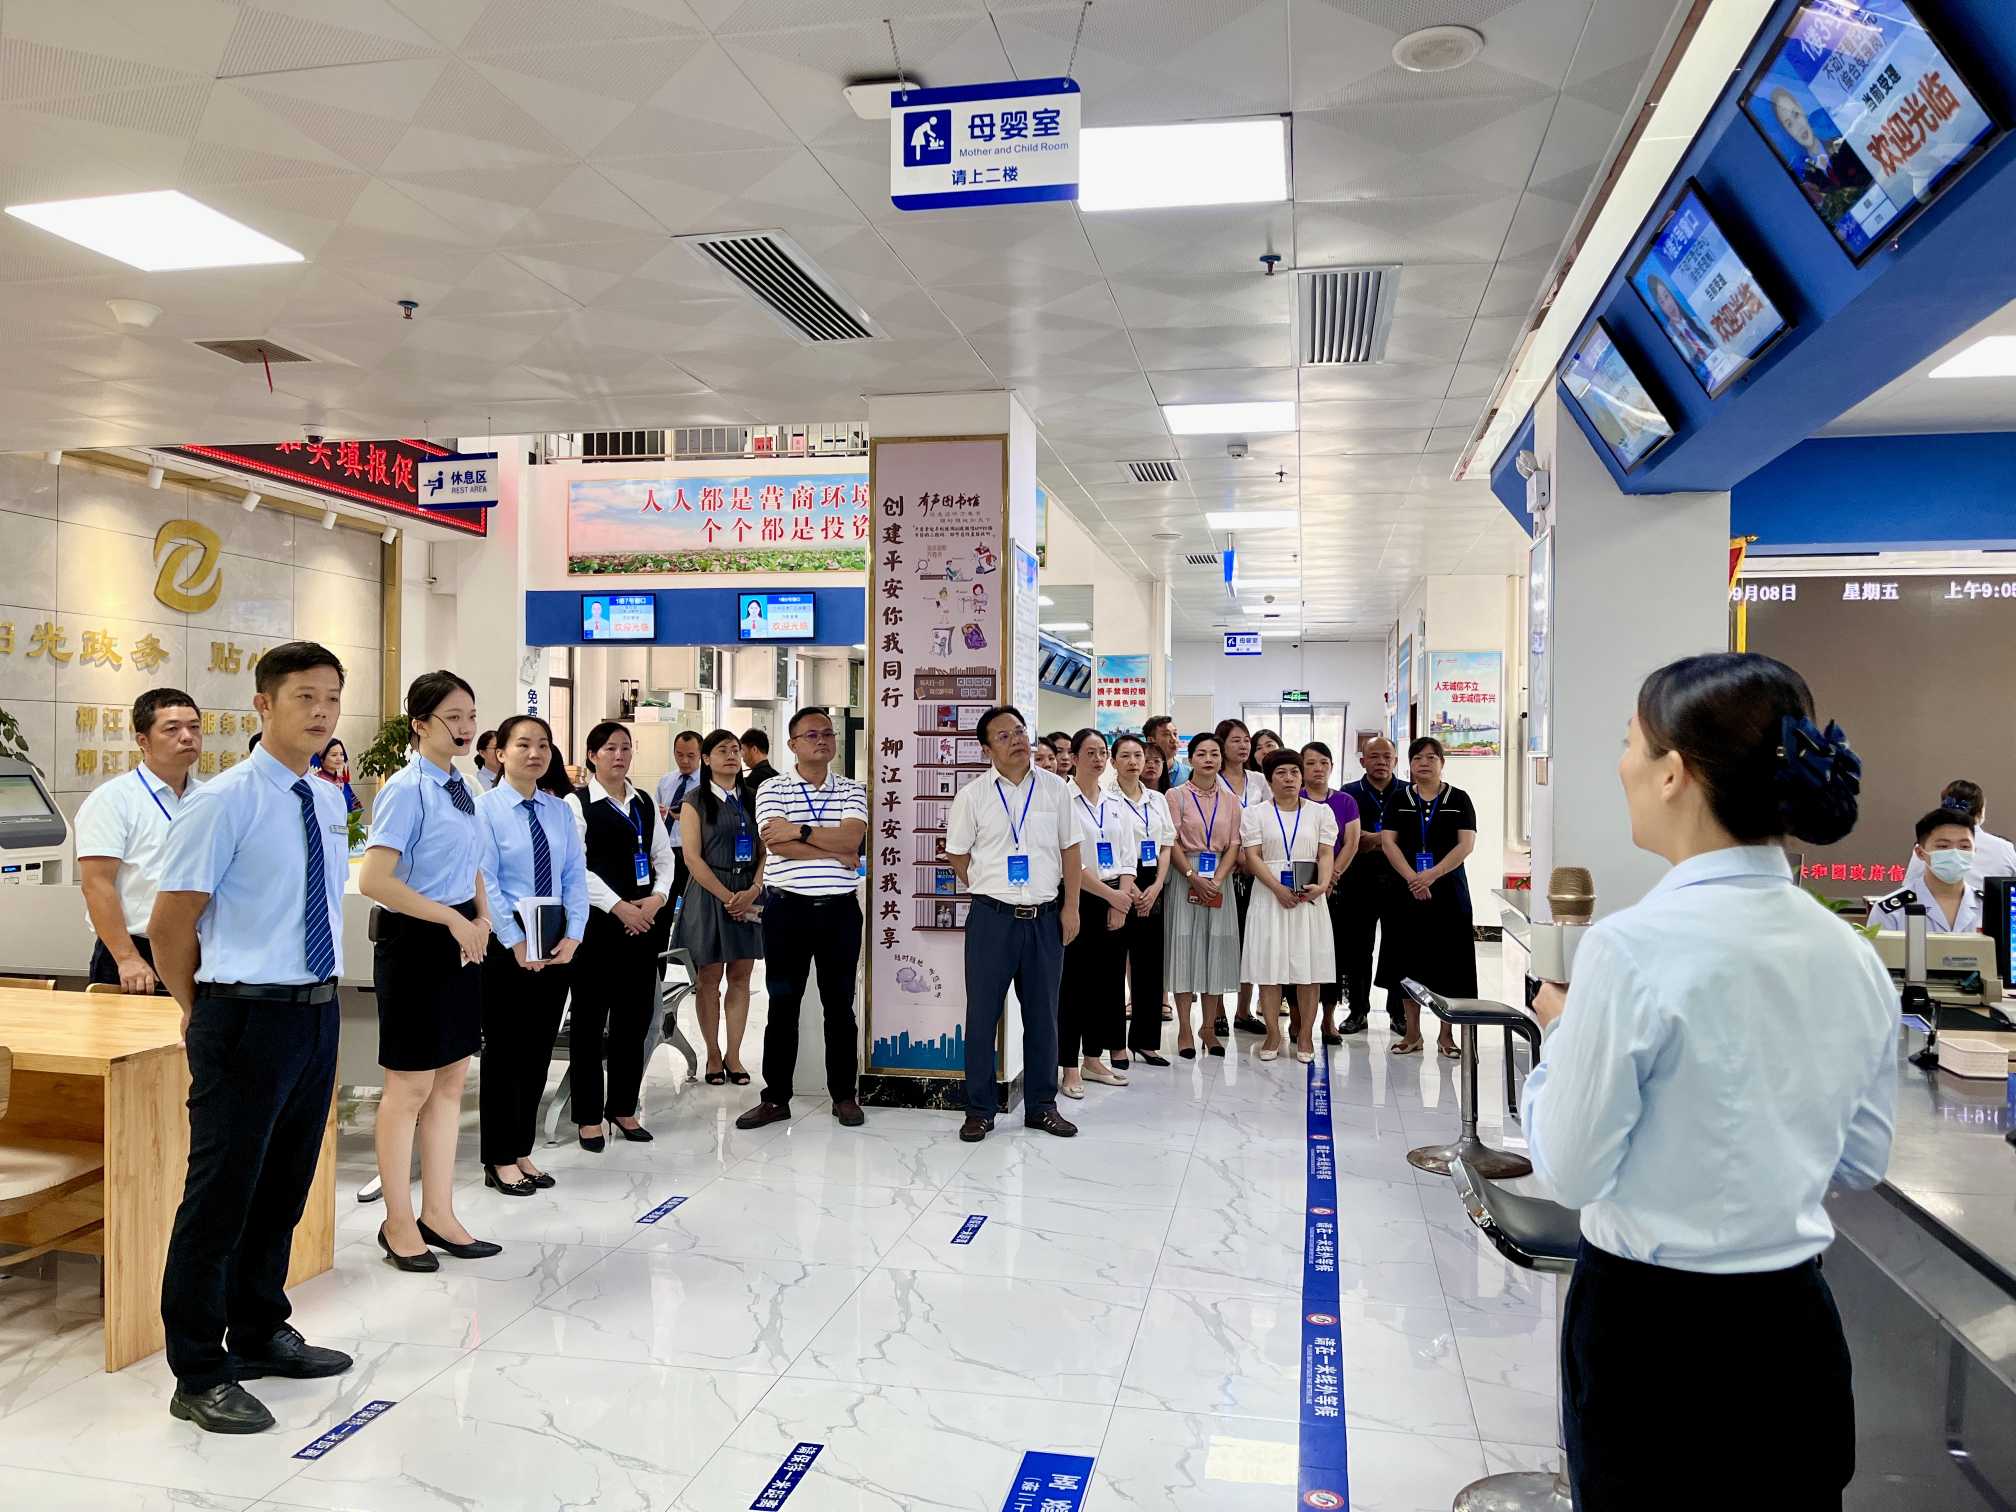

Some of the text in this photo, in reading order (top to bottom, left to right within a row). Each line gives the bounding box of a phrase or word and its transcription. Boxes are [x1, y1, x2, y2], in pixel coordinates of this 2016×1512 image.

[1862, 64, 1901, 112] 当前受理
[968, 107, 1061, 142] 母婴室
[1867, 71, 1960, 177] 欢迎光临
[959, 141, 1069, 158] Mother and Child Room
[952, 166, 1018, 186] 请上二楼
[1710, 282, 1764, 342] 欢迎光临
[451, 470, 487, 485] 休息区
[469, 486, 487, 494] AREA
[917, 491, 981, 517] 有声图书馆
[881, 495, 905, 709] 创建平安你我同行
[1729, 584, 1796, 601] 9月08日
[1842, 583, 1899, 601] 星期五
[1435, 681, 1479, 692] 人无诚信不立
[1451, 693, 1496, 703] 业无诚信不兴
[880, 737, 904, 949] 柳江平安你我共享
[1315, 1222, 1334, 1272] 请在一米线外等候
[1313, 1336, 1339, 1418] 请在一米线外等候
[756, 1446, 817, 1508] 请保持一米距离
